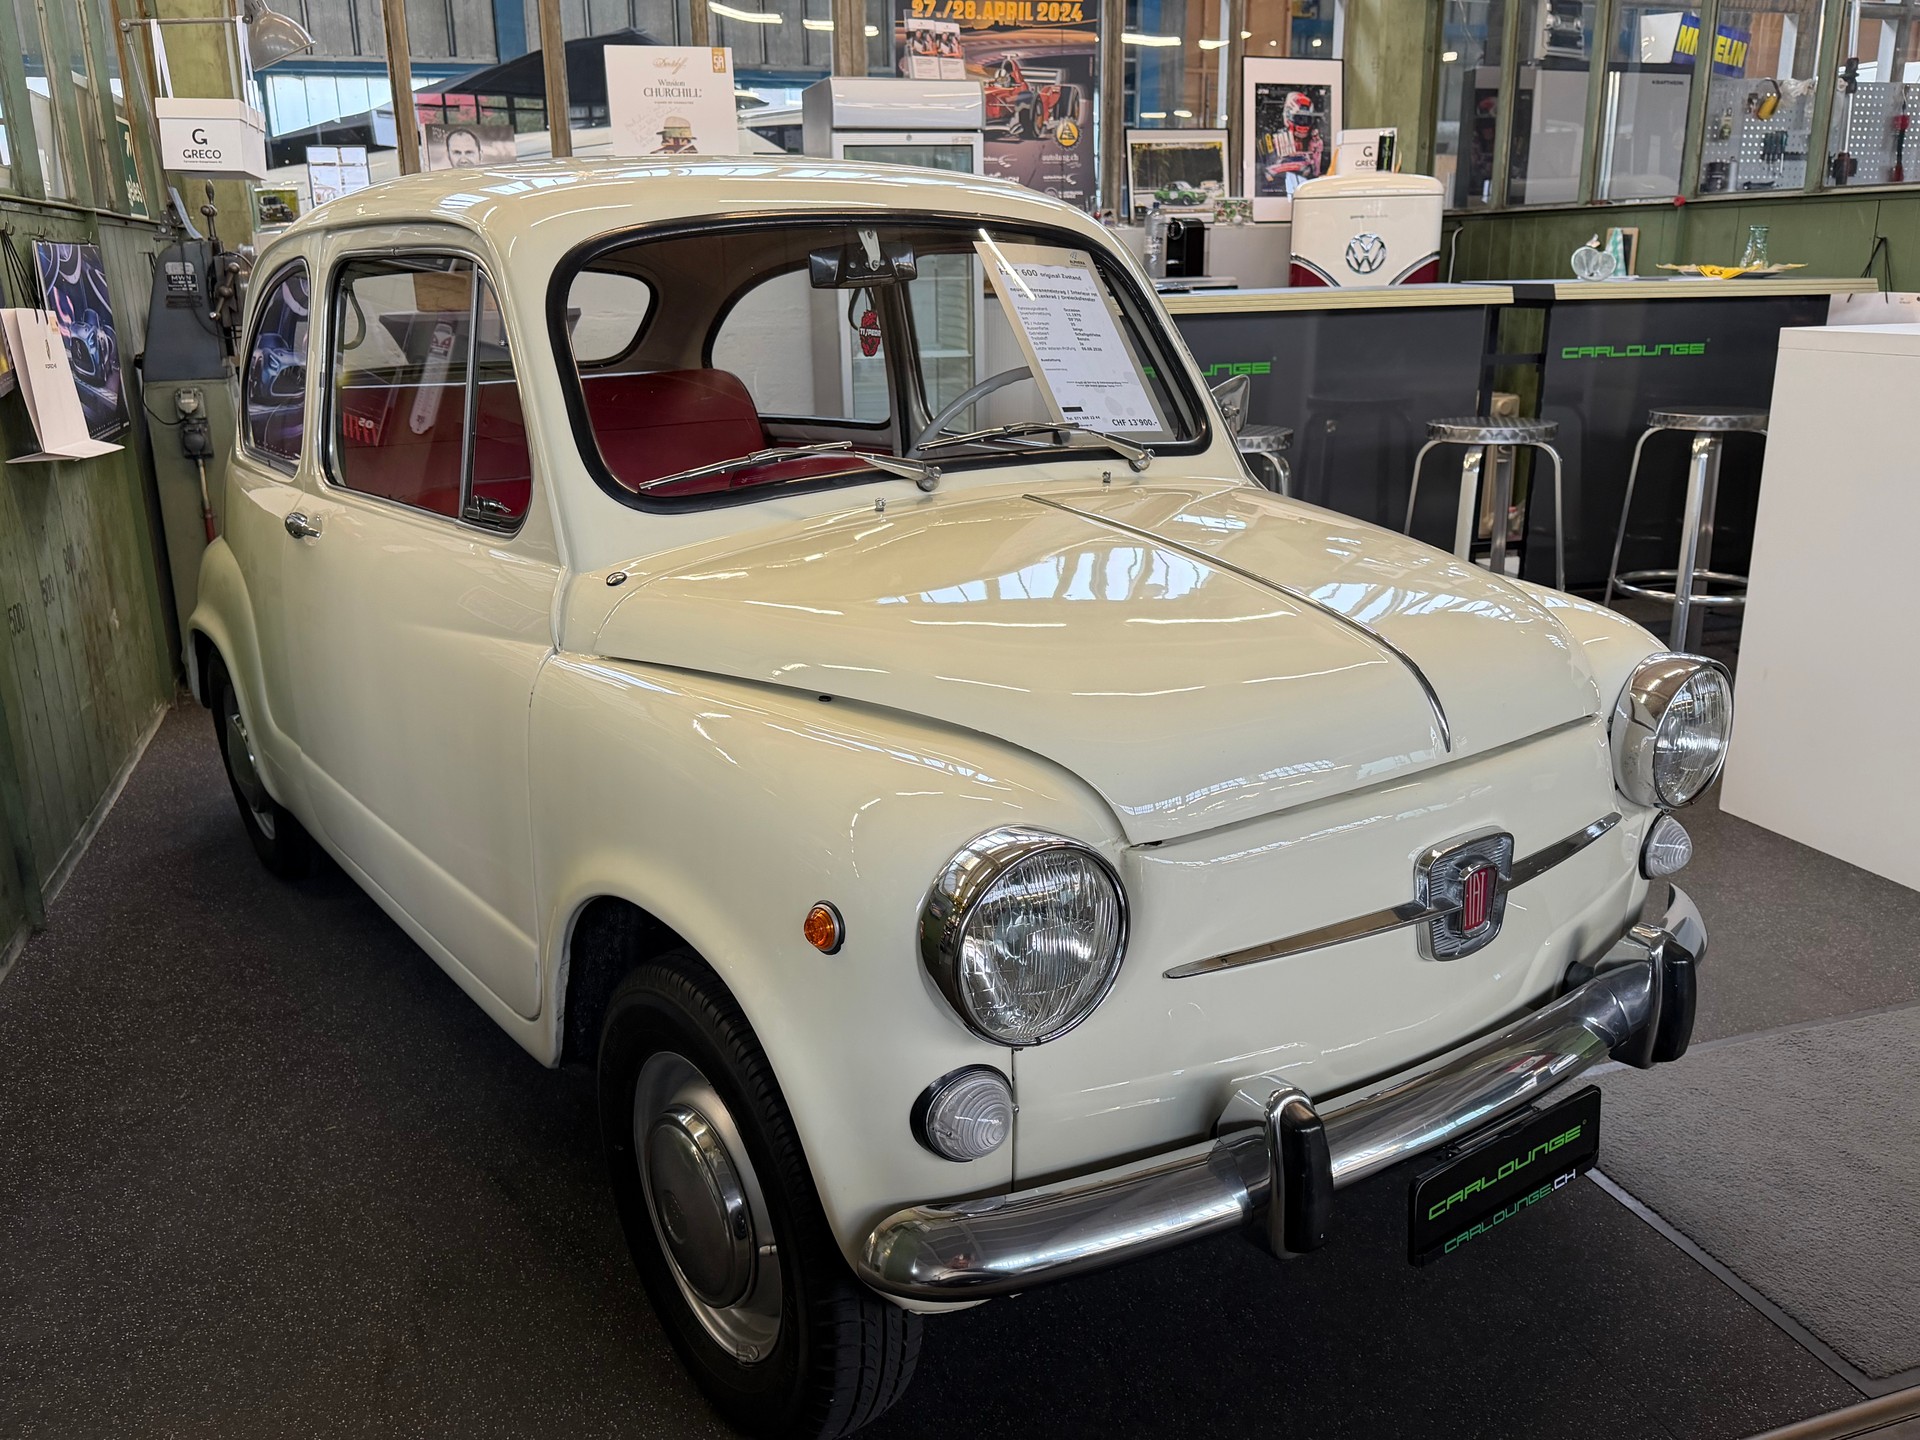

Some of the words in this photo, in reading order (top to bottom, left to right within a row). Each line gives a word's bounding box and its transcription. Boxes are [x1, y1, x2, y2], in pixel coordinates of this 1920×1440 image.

[1036, 2, 1084, 22] 2024
[1675, 25, 1748, 68] MIELIN
[657, 79, 686, 87] Winston
[182, 149, 222, 160] GRECO
[1021, 268, 1038, 277] 600
[1040, 272, 1061, 280] original
[1061, 273, 1082, 281] Zustand
[1562, 343, 1706, 359] CARLOUNGE
[1111, 418, 1127, 427] CHF
[1128, 418, 1158, 427] 13'900.-
[8, 602, 25, 637] 500
[1465, 871, 1487, 928] IAT
[1428, 1124, 1582, 1221] CARLOUNGE
[1444, 1168, 1577, 1254] CARLOUNGE.CH
